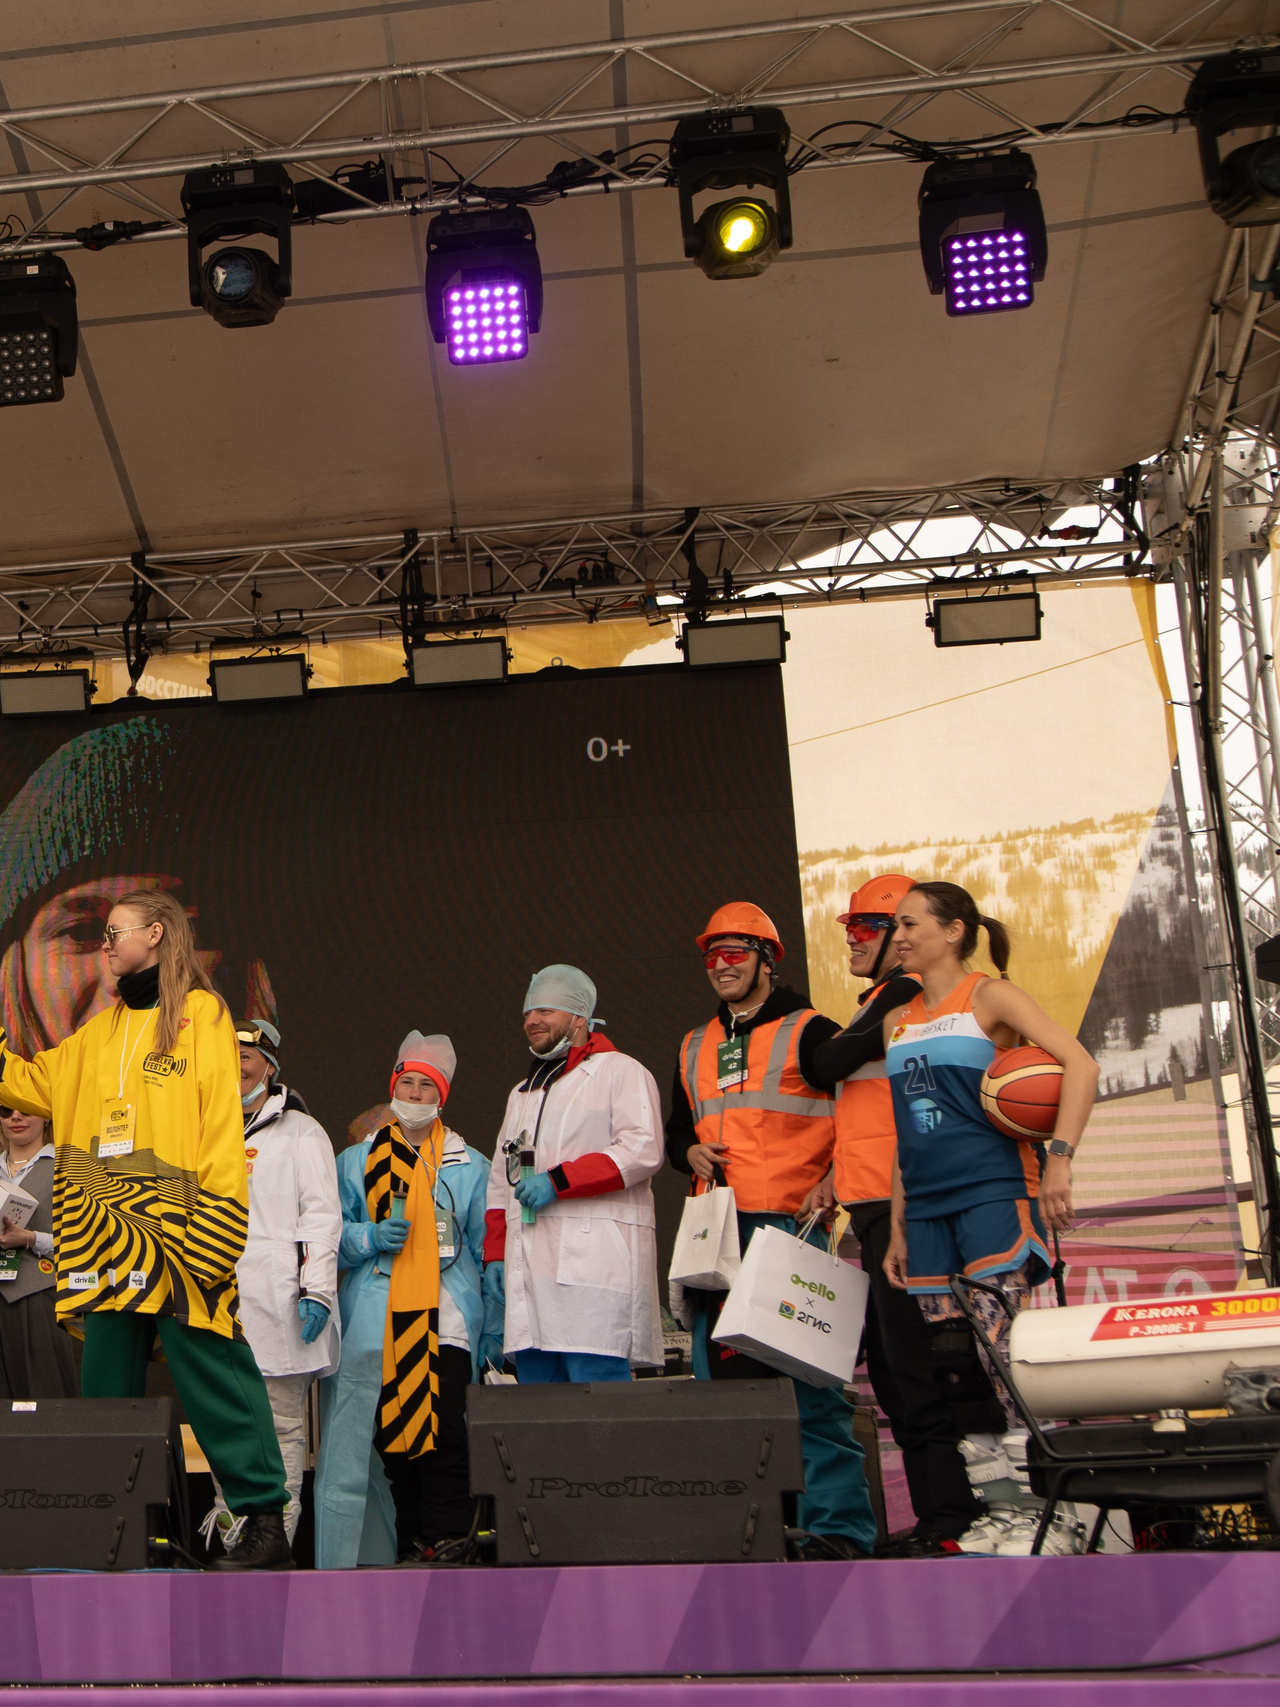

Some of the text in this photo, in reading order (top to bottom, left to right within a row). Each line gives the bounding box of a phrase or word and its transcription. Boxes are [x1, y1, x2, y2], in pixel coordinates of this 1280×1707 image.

[136, 674, 212, 698] ВОССТАН
[586, 736, 631, 762] 0+
[146, 1062, 163, 1071] FEST
[903, 1053, 937, 1095] 21
[74, 1275, 97, 1286] drivee
[1112, 1296, 1280, 1322] KERONA 3000
[797, 1311, 833, 1334] 2ГИС
[1128, 1321, 1197, 1337] P-3000E-T
[525, 1476, 748, 1498] ProTone
